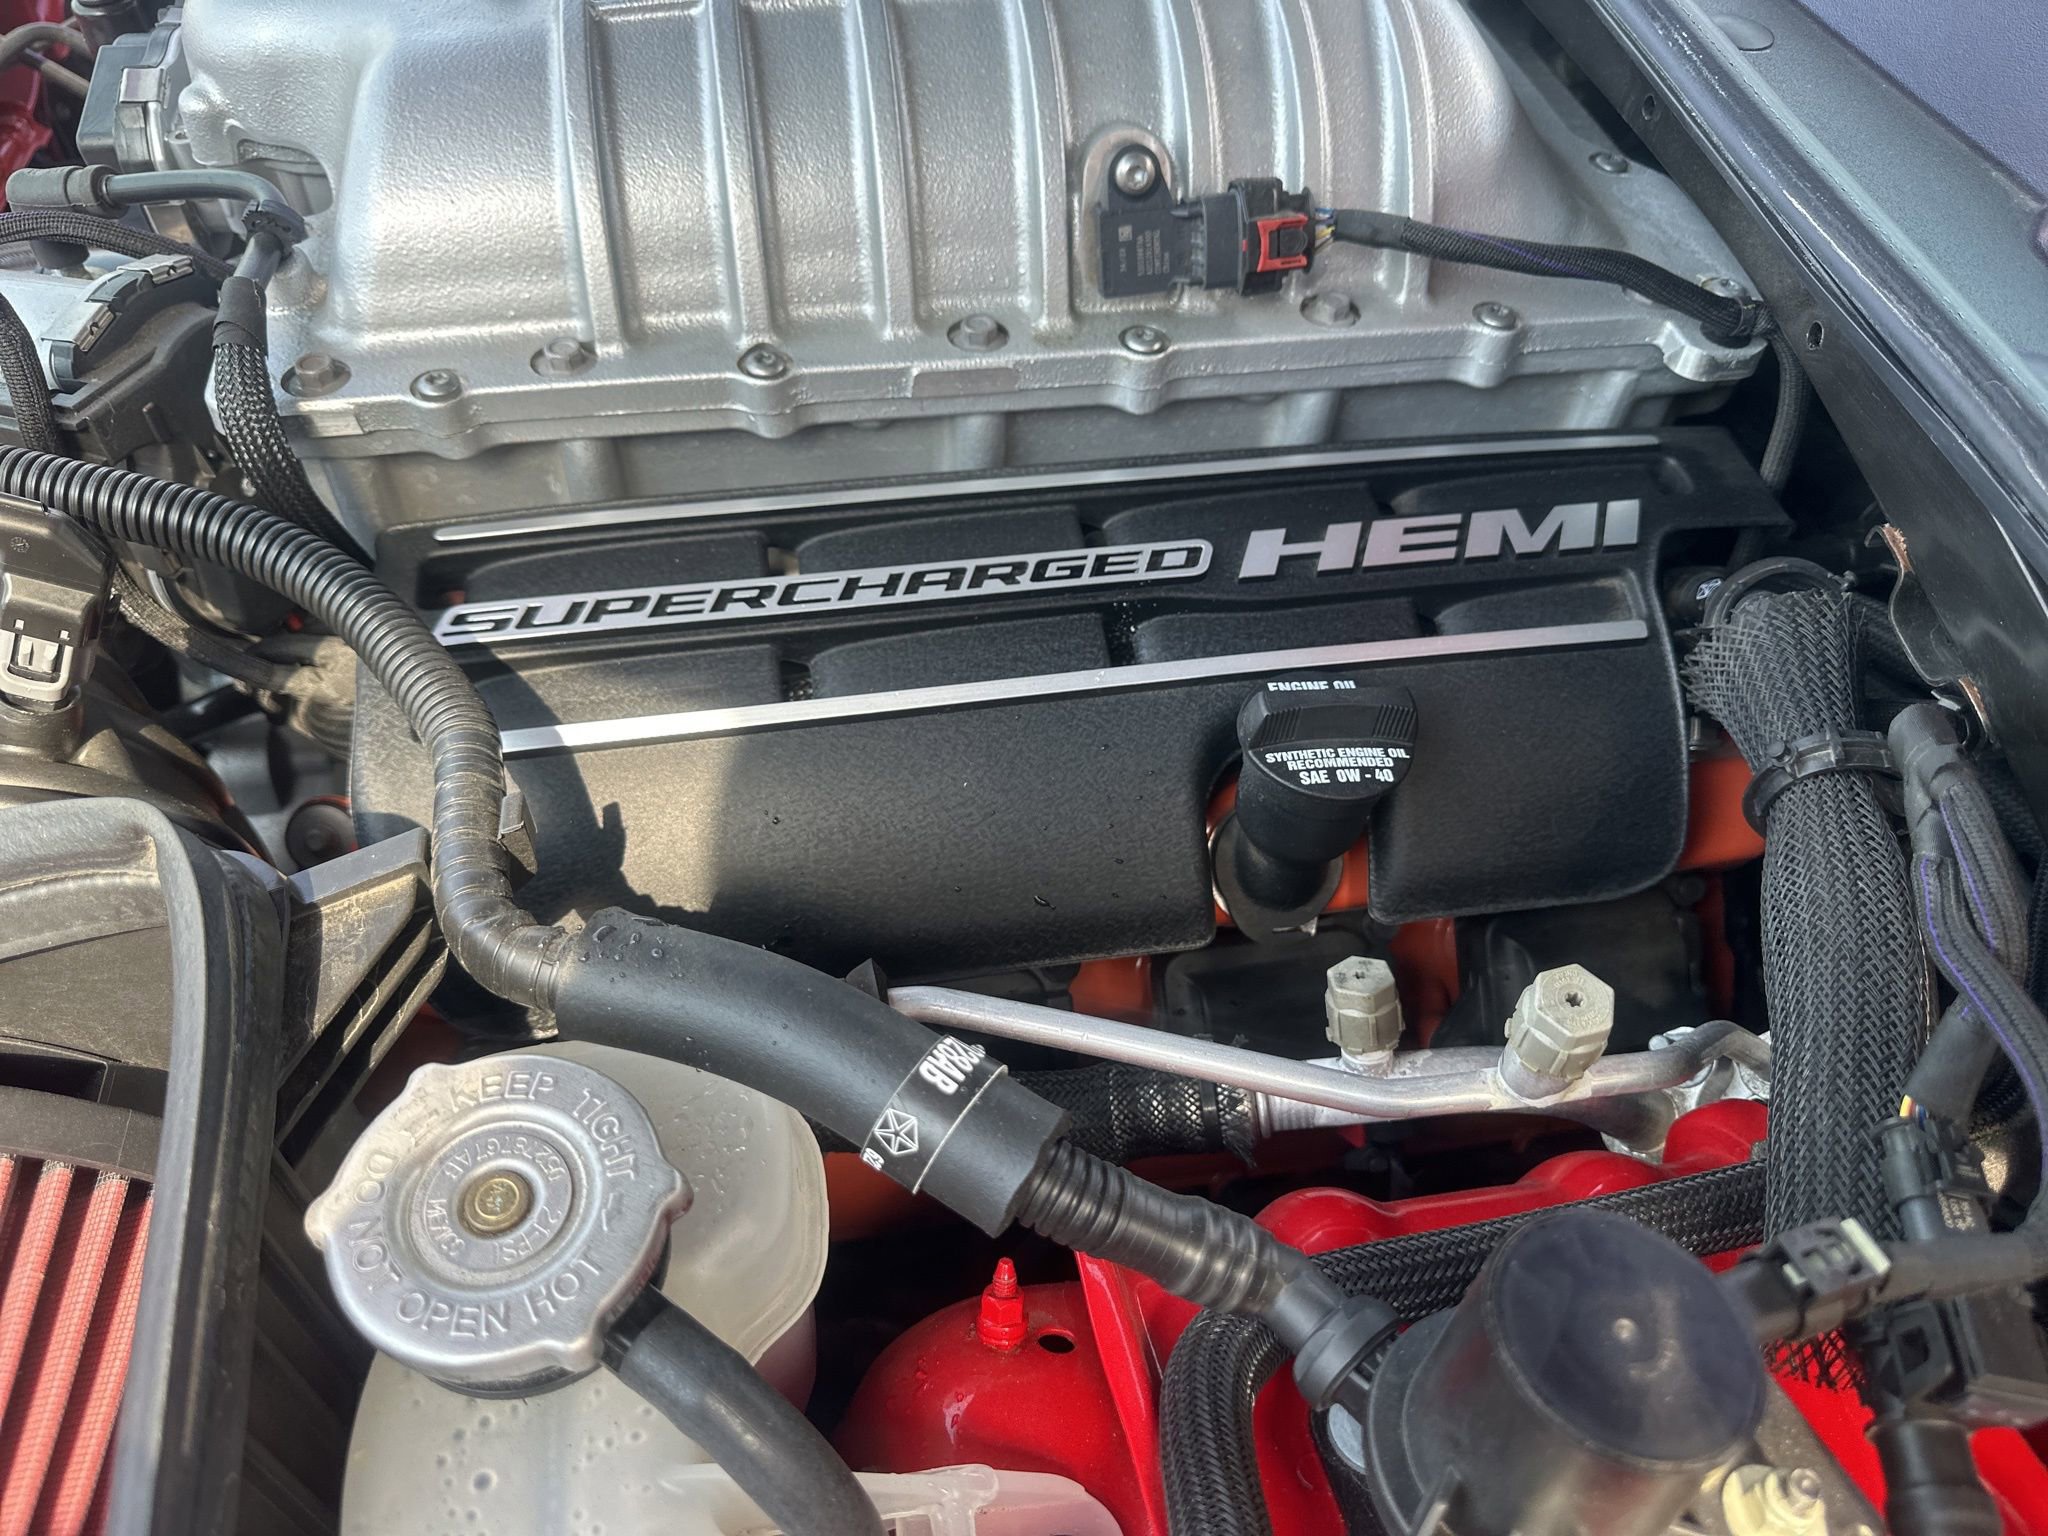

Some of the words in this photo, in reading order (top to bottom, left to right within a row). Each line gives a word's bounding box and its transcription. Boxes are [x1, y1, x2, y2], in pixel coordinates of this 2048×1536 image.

[440, 545, 1204, 637] SUPERCHARGED
[1238, 499, 1640, 581] HEMI
[1266, 680, 1329, 692] ENGINE
[1264, 750, 1336, 764] SYNTHETIC
[1337, 747, 1385, 758] ENGINE
[1387, 747, 1411, 759] OIL
[1287, 758, 1395, 771] RECOMMENDED
[1299, 769, 1331, 786] SAE
[450, 1070, 555, 1113] KEEP
[571, 1088, 638, 1182] TIGHT
[349, 1215, 410, 1294] NOT
[396, 1291, 508, 1340] OPEN
[523, 1254, 600, 1325] HOT
